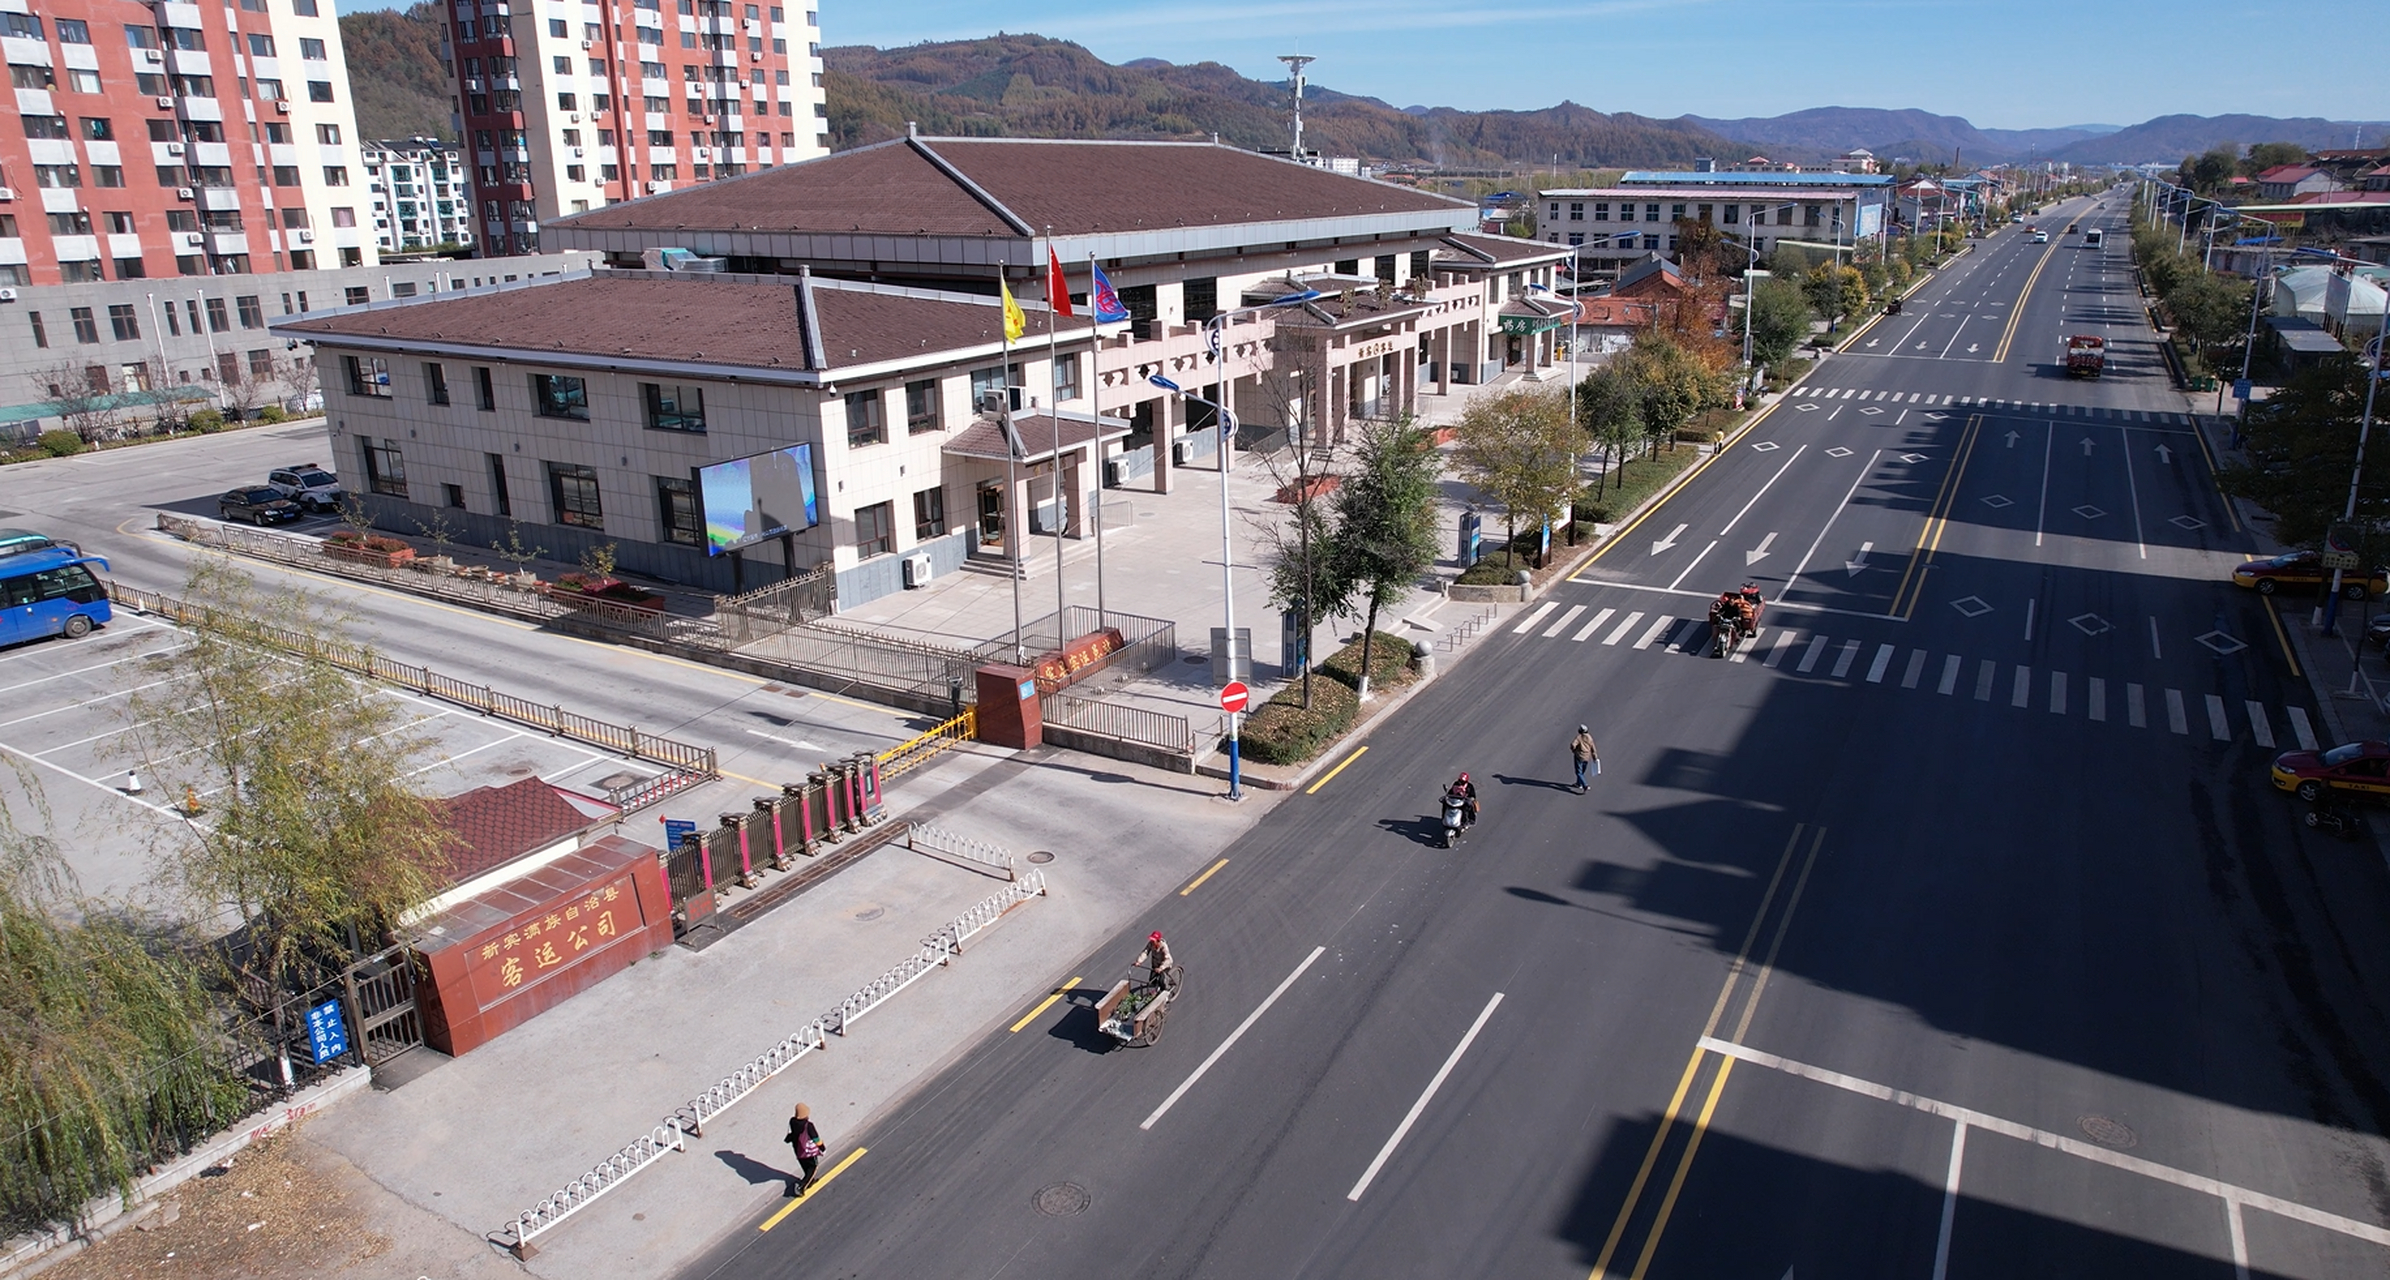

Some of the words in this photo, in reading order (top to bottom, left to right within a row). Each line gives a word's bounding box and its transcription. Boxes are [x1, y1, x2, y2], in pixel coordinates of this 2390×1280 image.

[1503, 319, 1527, 332] 药房
[481, 886, 619, 960] 新宾满族自治县
[501, 910, 616, 987] 客运公司
[323, 1004, 342, 1054] 禁止入内
